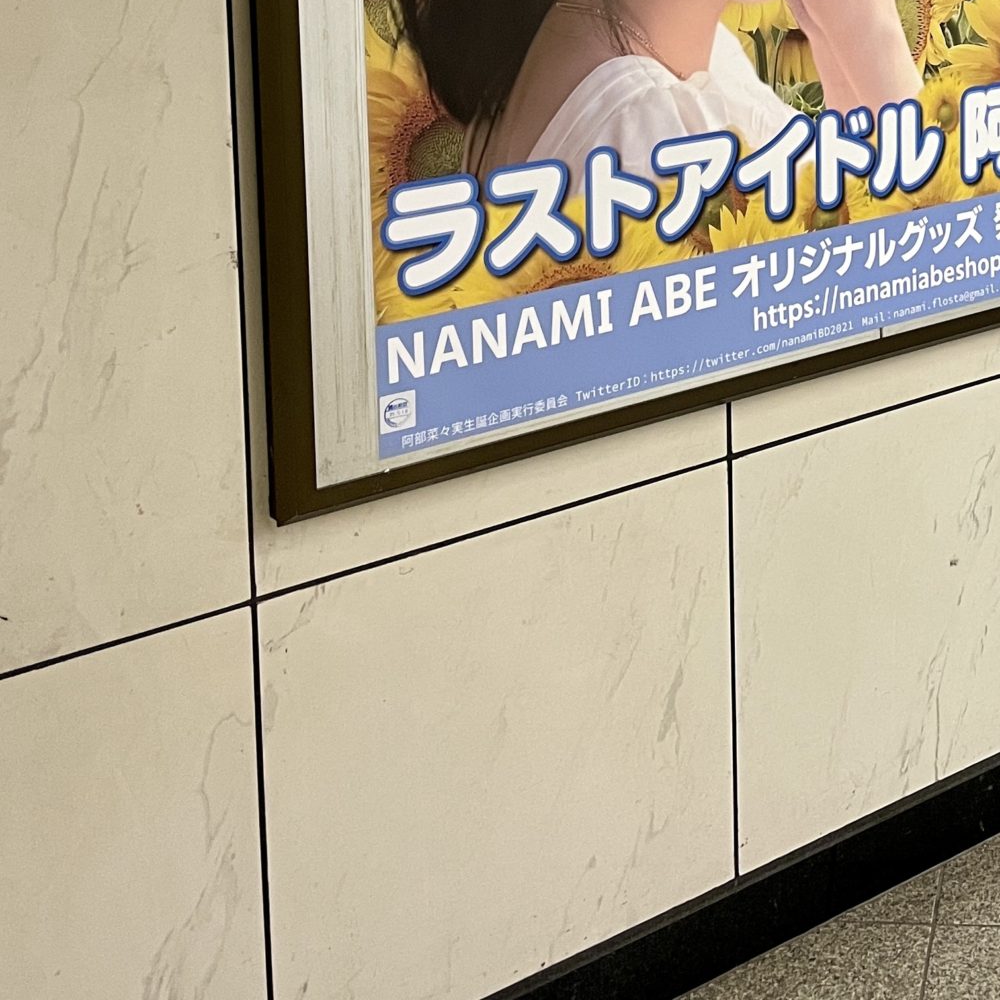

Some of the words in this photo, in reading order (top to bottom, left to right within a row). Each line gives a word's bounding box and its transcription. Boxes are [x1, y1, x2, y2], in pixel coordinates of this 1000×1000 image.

[380, 100, 944, 296] ラストアイドル
[386, 289, 614, 385] NANAMI
[629, 265, 718, 328] ABE
[732, 204, 984, 298] オリジナルグッズ
[401, 394, 569, 449] 阿部菜々実生誕企画実行委員会
